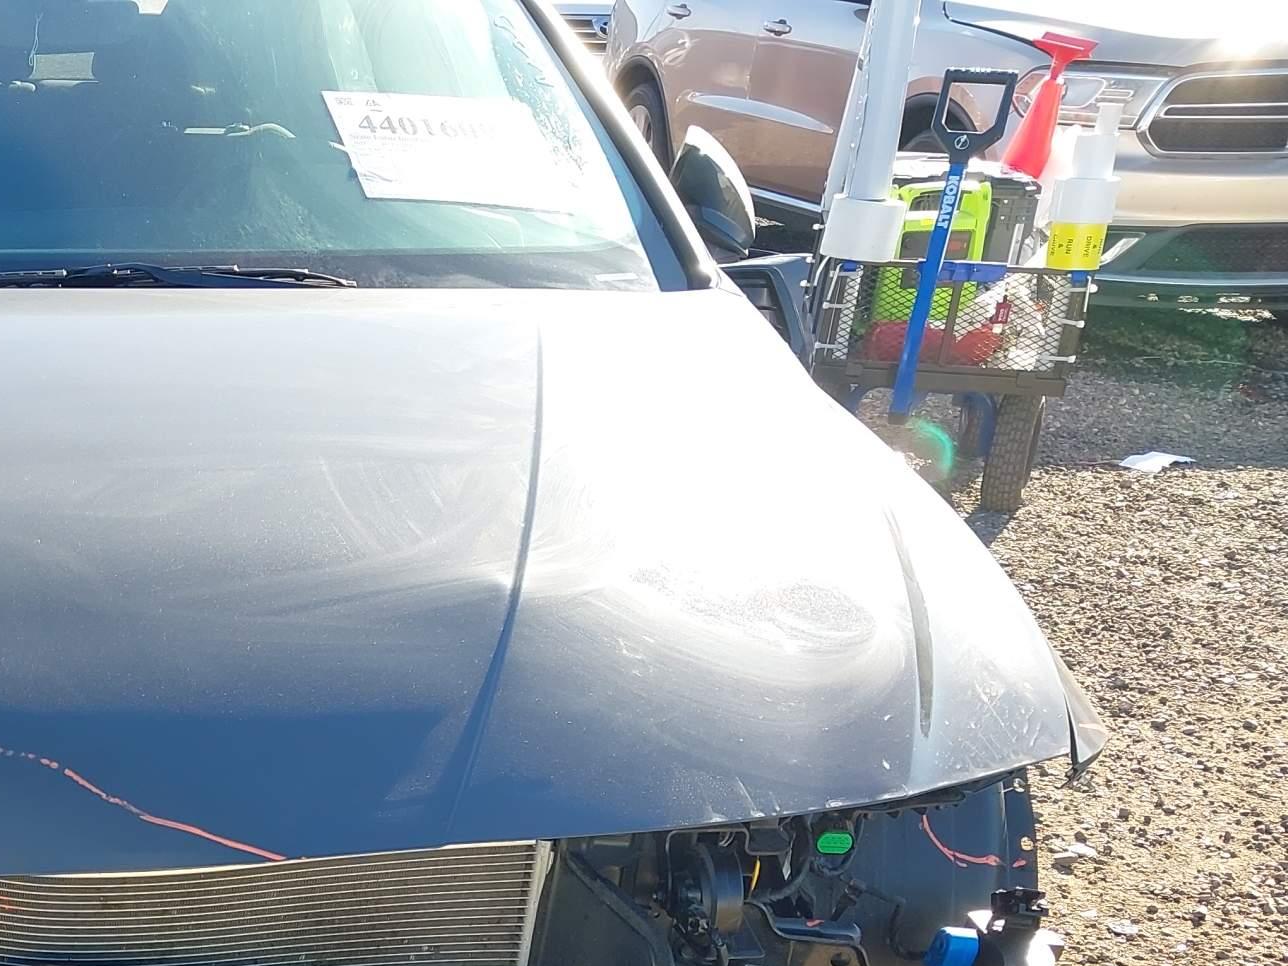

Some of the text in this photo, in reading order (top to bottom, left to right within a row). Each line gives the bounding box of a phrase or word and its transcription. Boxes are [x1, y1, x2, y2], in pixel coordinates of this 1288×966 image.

[936, 175, 961, 229] KOBALT
[1064, 238, 1074, 255] RUN
[1082, 235, 1093, 258] DRIVE
